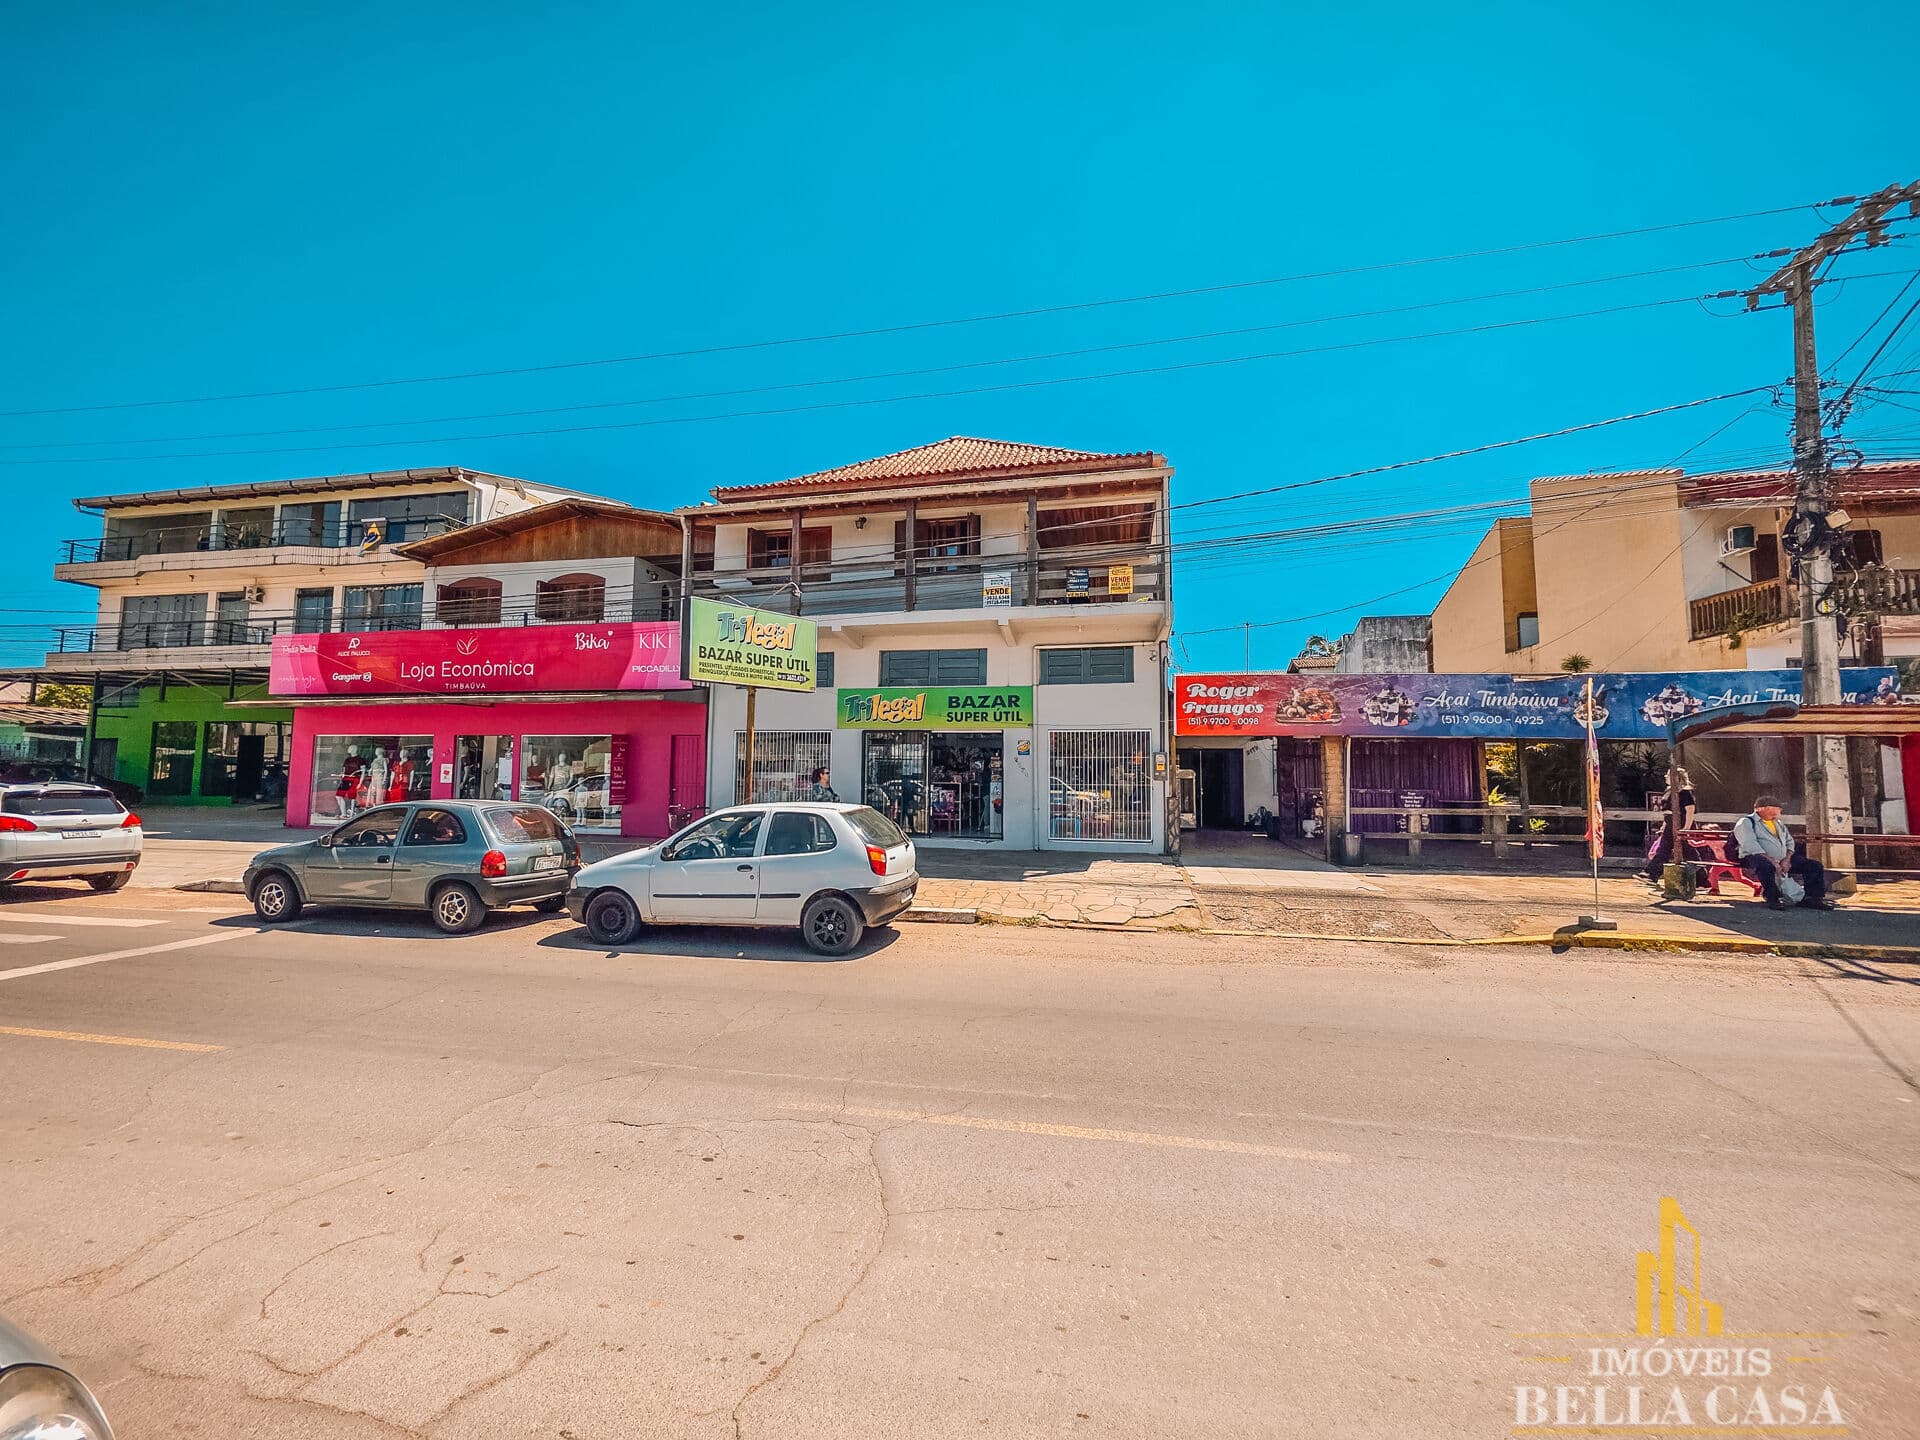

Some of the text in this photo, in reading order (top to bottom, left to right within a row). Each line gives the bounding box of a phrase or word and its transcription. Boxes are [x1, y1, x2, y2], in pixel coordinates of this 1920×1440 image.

[985, 587, 1010, 596] VENDE
[574, 631, 611, 651] Bika
[639, 632, 673, 649] KIKI
[698, 645, 811, 672] BAZAR SUPER ÚTIL
[332, 672, 362, 683] Gangster
[400, 660, 535, 682] Loja Econômica
[444, 681, 487, 690] TIMBAÚVA
[1186, 683, 1260, 700] Roger
[947, 694, 1021, 709] BAZAR
[1476, 690, 1559, 708] Timbaúva
[946, 708, 1023, 723] SUPER ÚTIL
[1182, 701, 1265, 716] Frangos
[1209, 717, 1230, 725] 9700
[1237, 717, 1259, 725] 0098
[1441, 714, 1460, 725] (51)
[1462, 715, 1470, 724] 9
[1472, 715, 1503, 725] 9600
[1514, 715, 1544, 725] 4925
